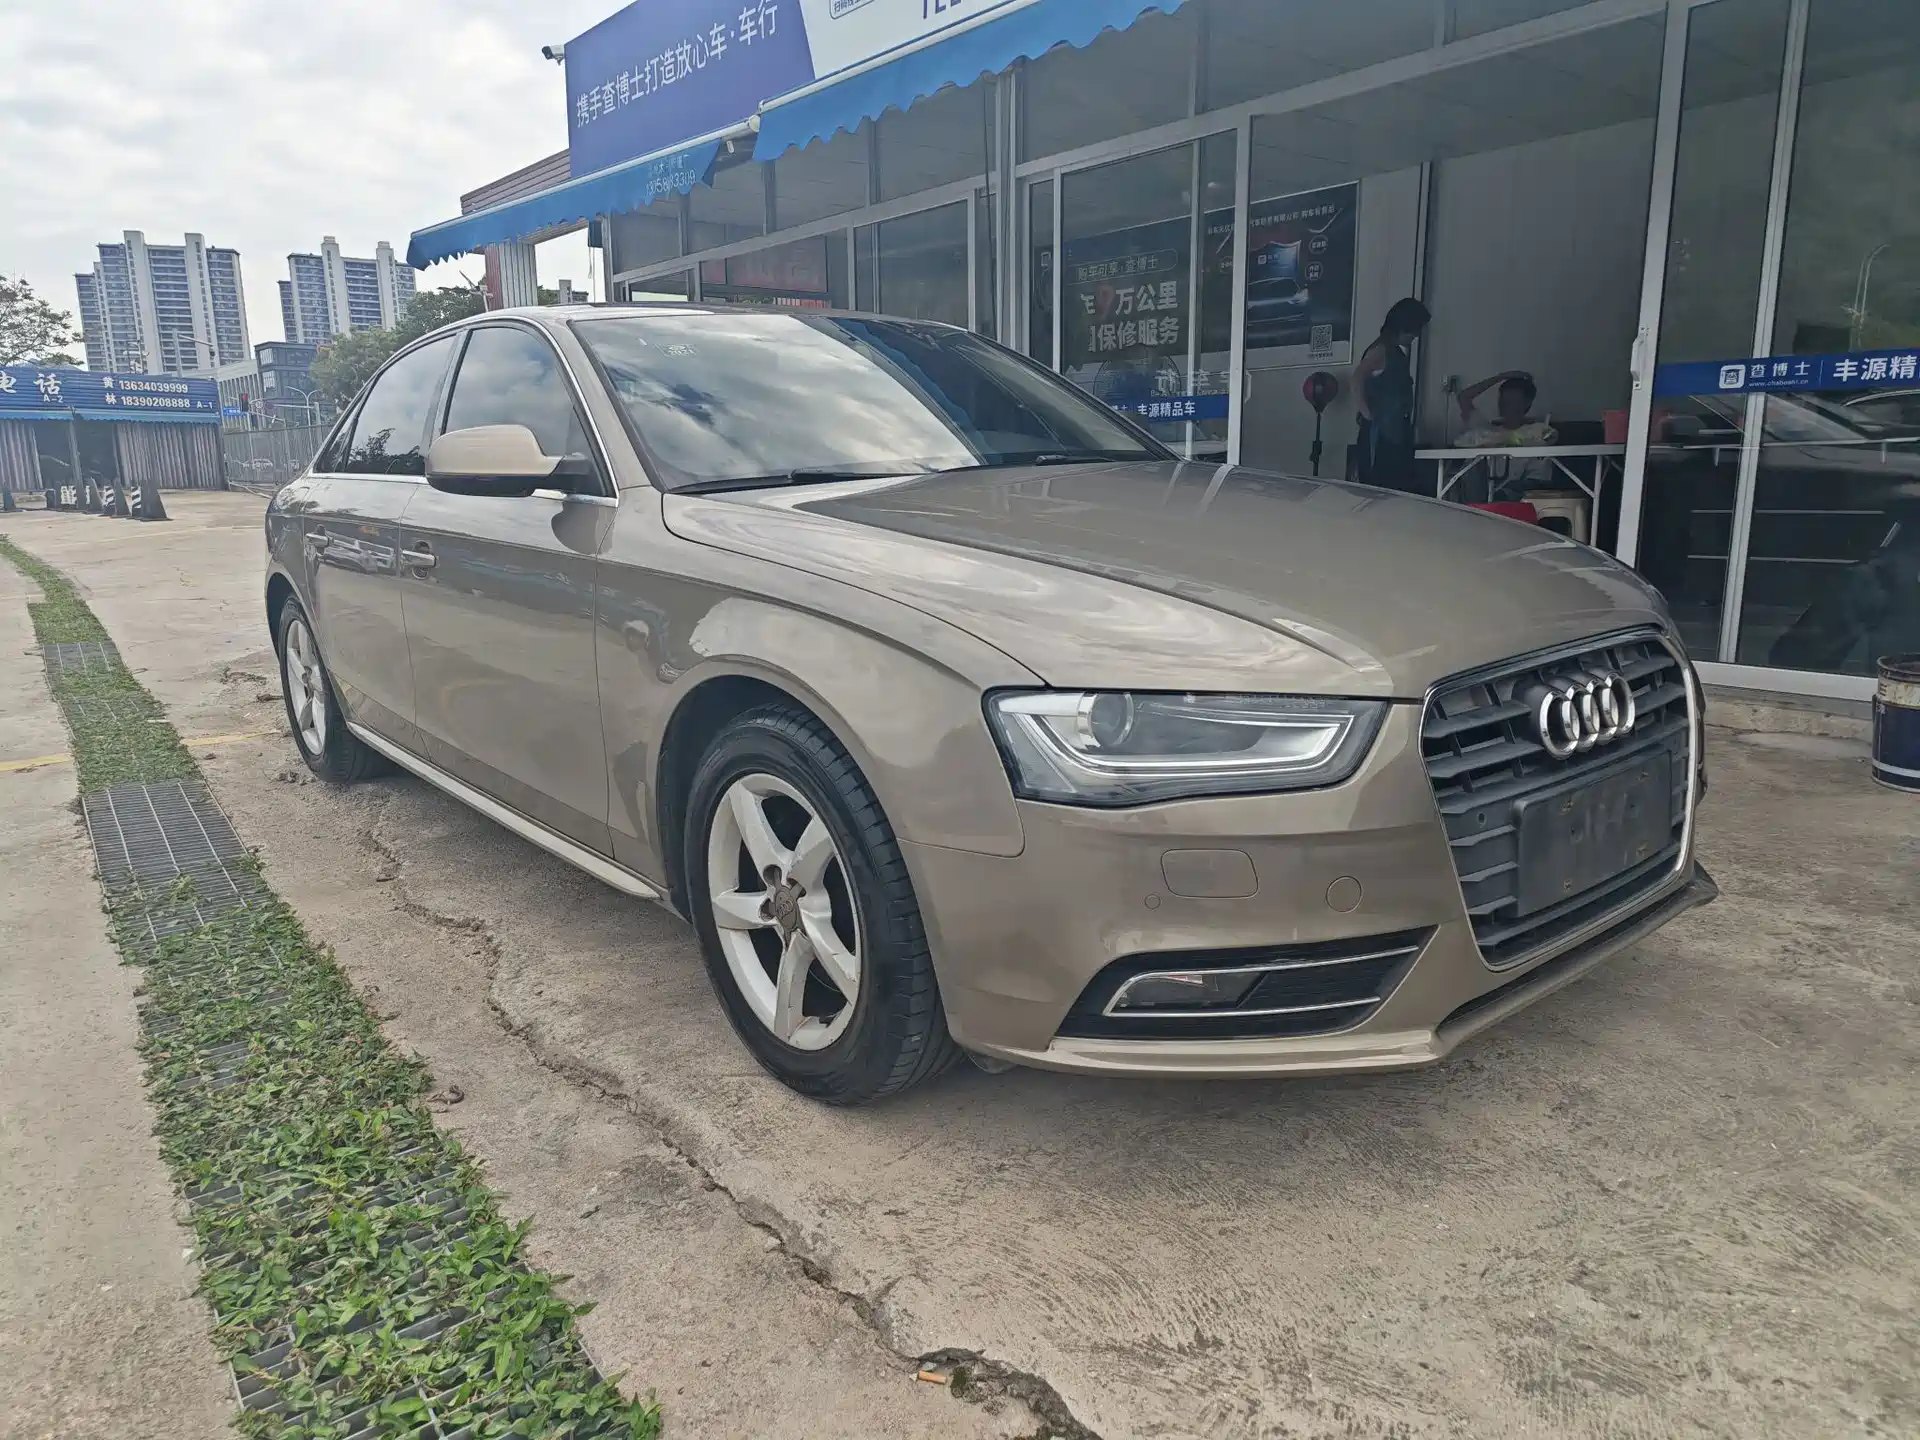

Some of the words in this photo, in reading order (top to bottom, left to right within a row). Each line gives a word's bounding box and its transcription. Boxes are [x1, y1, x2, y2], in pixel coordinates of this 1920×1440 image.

[1750, 361, 1811, 379] 查博士
[1833, 354, 1920, 382] 丰源精
[119, 380, 189, 393] 13634039999
[121, 396, 191, 408] 18390208888
